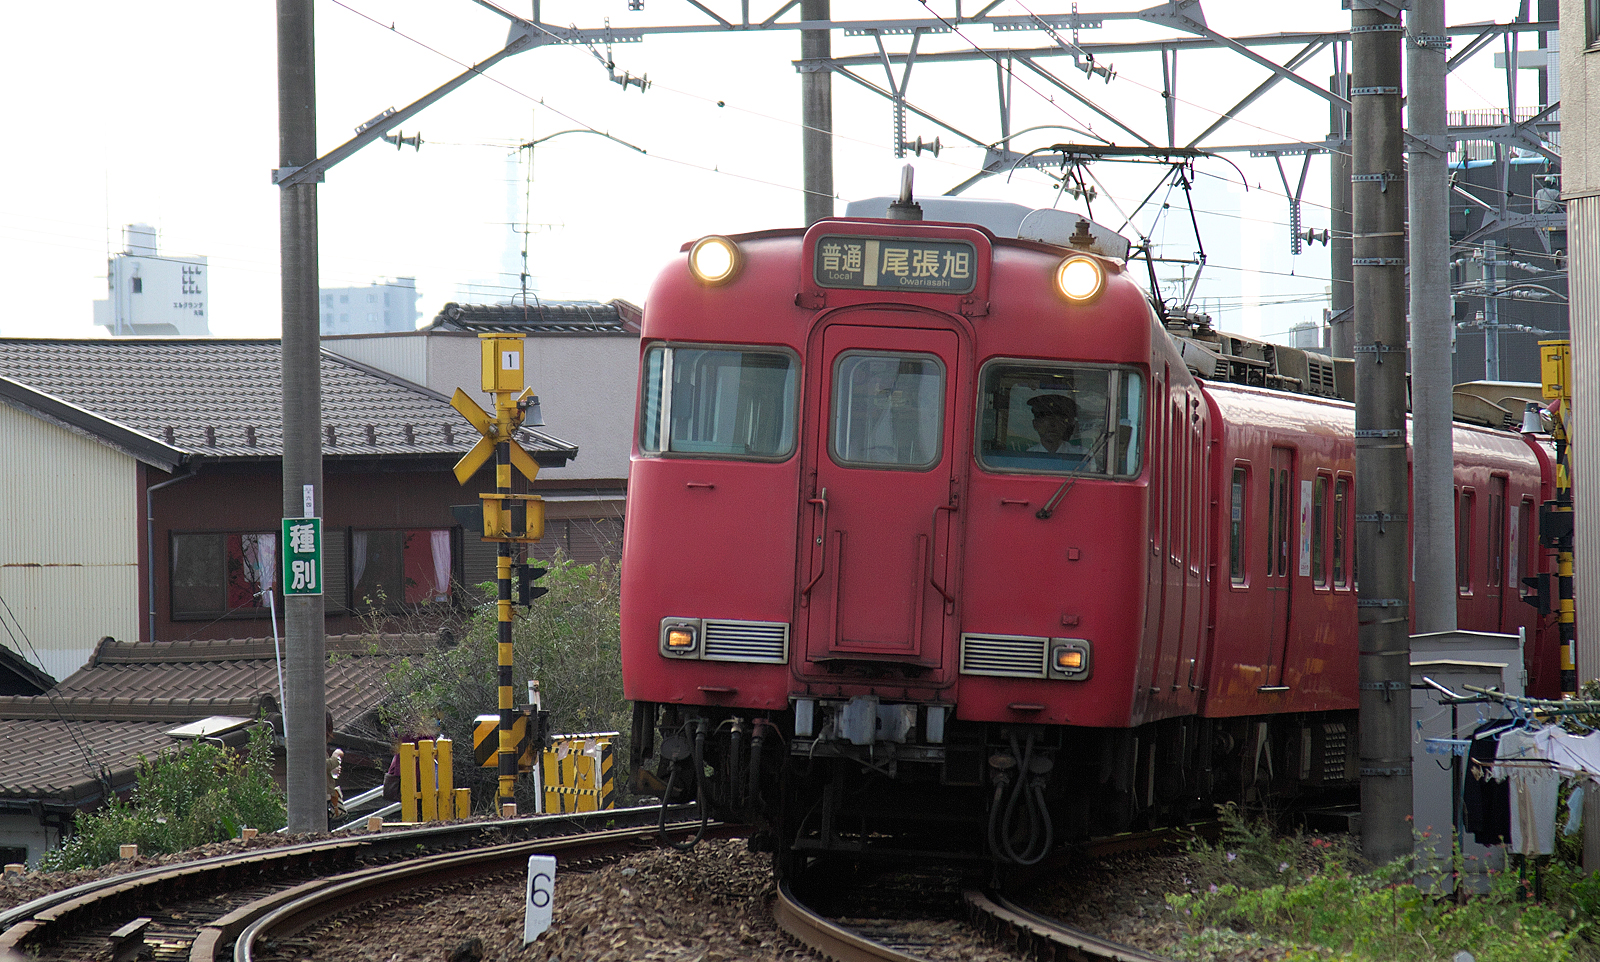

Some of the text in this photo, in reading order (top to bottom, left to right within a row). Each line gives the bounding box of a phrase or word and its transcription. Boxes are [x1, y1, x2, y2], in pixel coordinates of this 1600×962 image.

[822, 243, 862, 272] 普通
[881, 248, 970, 279] 尾張旭
[828, 270, 853, 280] Local
[899, 276, 951, 288] Owariasahi
[508, 353, 513, 368] 1
[290, 523, 316, 589] 種別
[531, 873, 551, 907] 6
